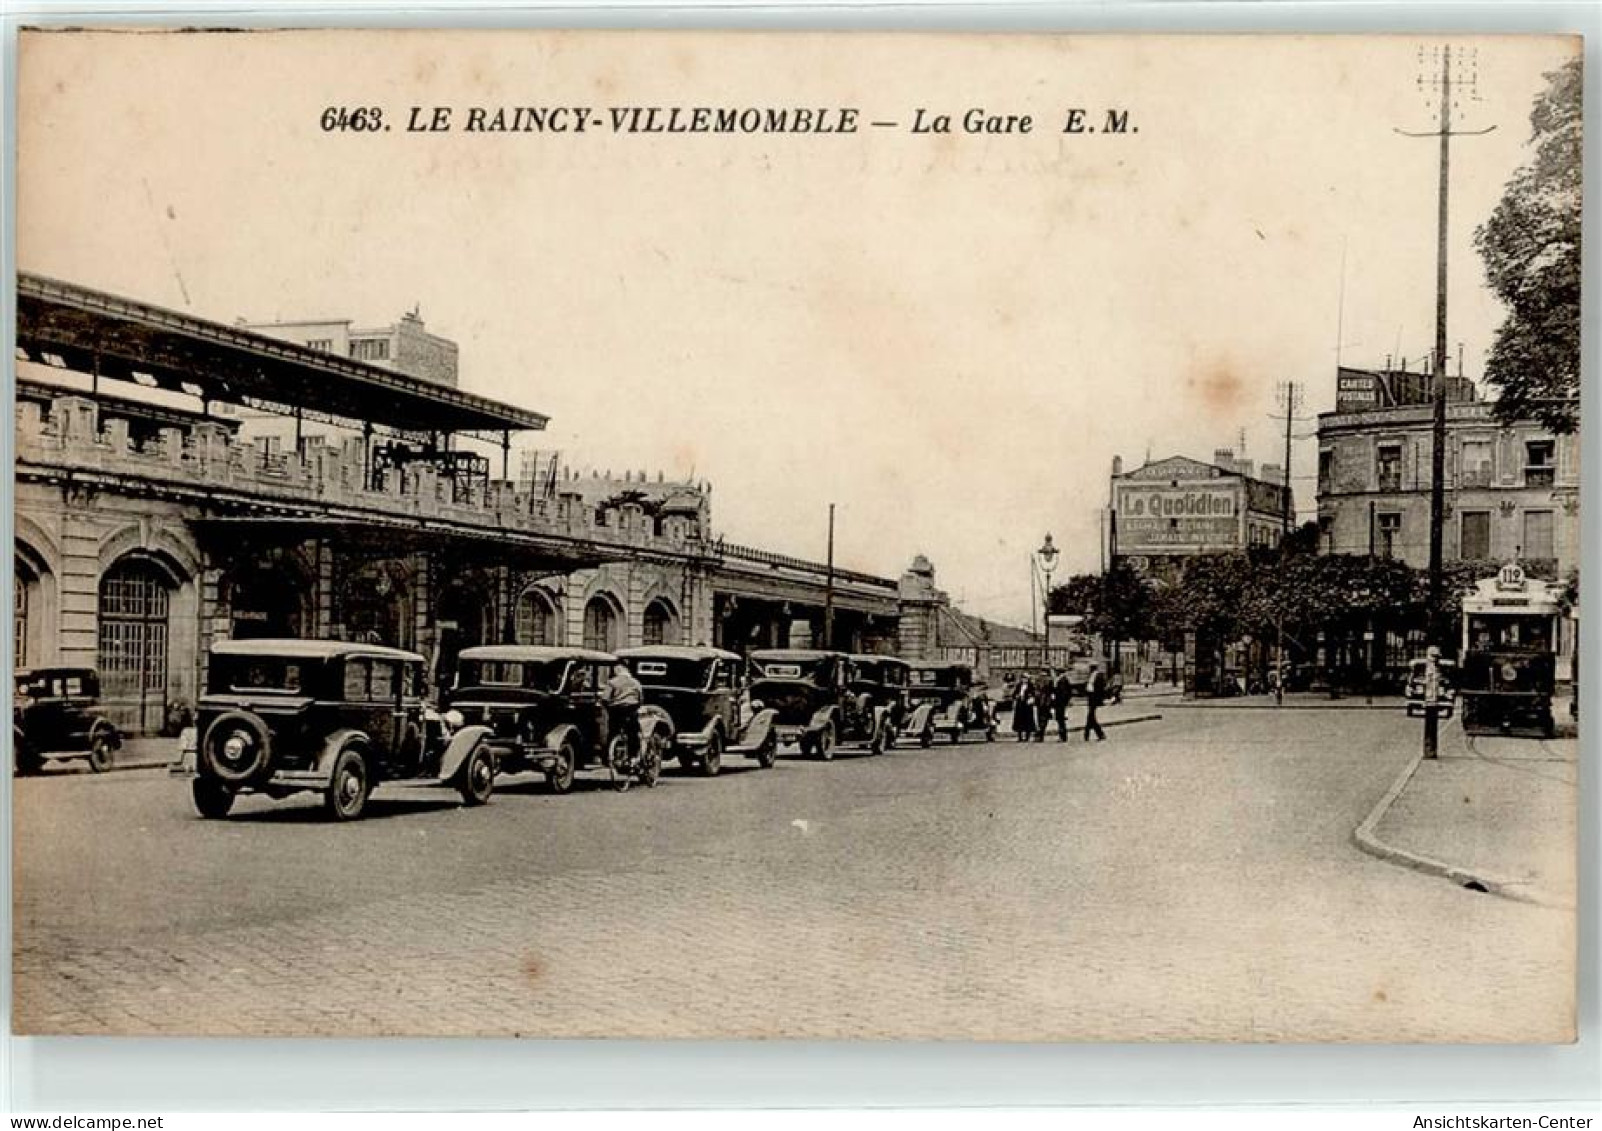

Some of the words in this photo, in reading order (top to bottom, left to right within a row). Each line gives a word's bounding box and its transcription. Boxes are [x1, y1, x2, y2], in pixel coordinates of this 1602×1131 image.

[321, 108, 390, 132] 6463.
[407, 108, 451, 131] LE
[465, 108, 858, 132] RAINCY-VILLEMOMBLE
[912, 110, 950, 132] La
[964, 110, 1031, 133] Gare
[1123, 494, 1144, 516] Le
[1147, 493, 1232, 517] Quotidien
[1502, 568, 1521, 584] 112
